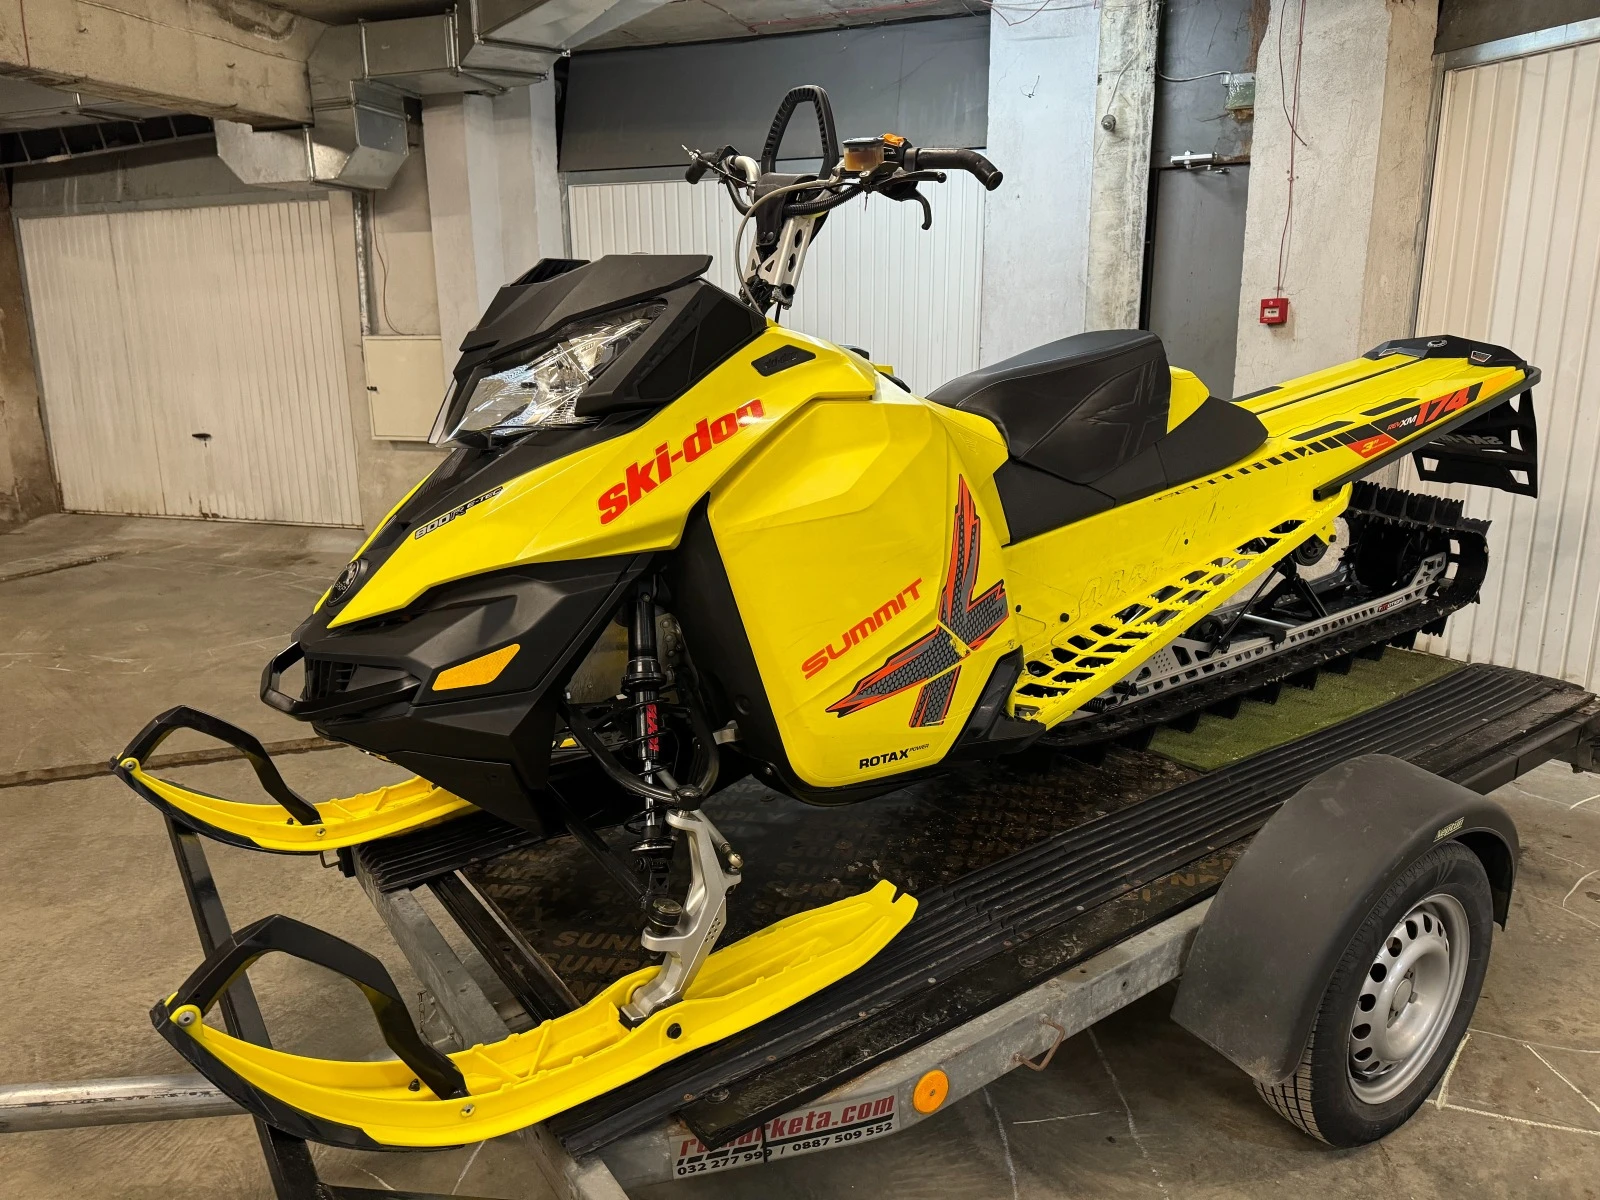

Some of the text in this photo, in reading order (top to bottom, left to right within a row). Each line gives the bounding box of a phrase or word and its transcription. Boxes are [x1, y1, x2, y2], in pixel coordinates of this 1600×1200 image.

[1415, 386, 1471, 426] 174
[597, 399, 765, 525] ski-doo
[801, 577, 923, 681] SUMMIT
[859, 748, 909, 769] ROTAX
[677, 1163, 707, 1176] 032
[710, 1155, 739, 1169] 277
[792, 1137, 829, 1152] 0887
[834, 1130, 862, 1143] 509
[866, 1122, 893, 1136] 552
